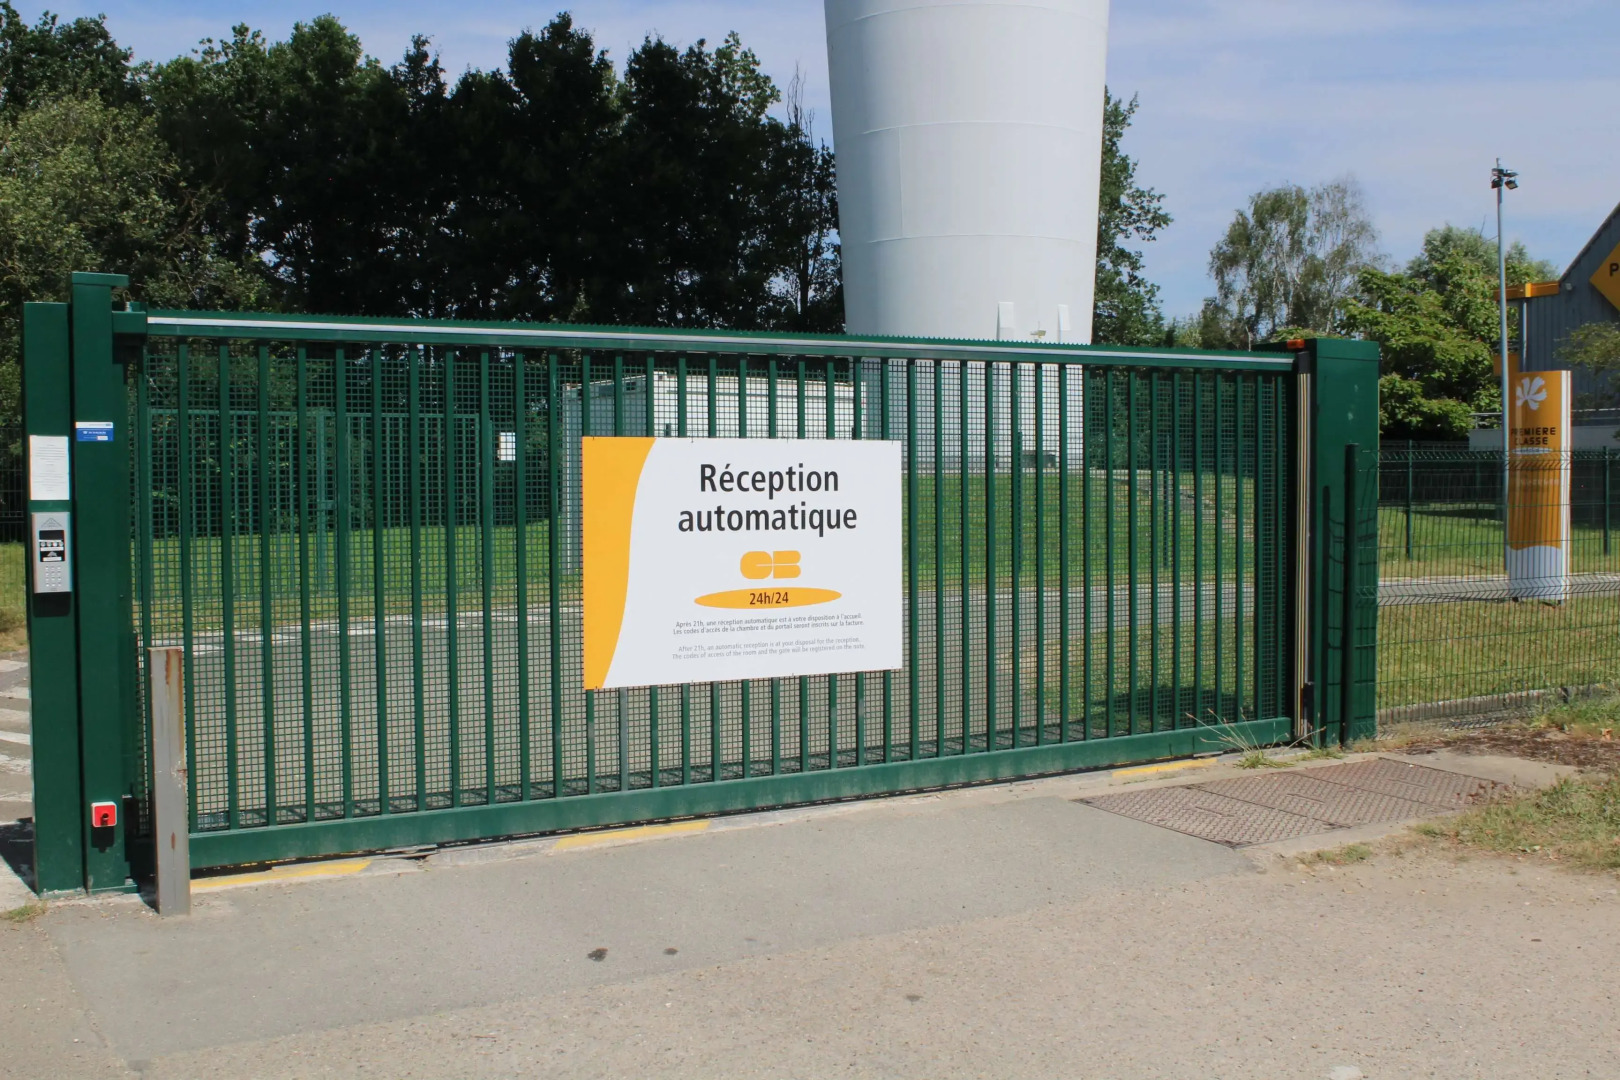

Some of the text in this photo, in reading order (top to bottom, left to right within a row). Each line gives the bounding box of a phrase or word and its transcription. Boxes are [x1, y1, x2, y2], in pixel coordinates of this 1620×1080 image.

[700, 463, 839, 500] Réception
[678, 502, 857, 537] automatique
[749, 591, 789, 605] 24h/24
[744, 641, 768, 650] reception
[810, 644, 835, 653] registered
